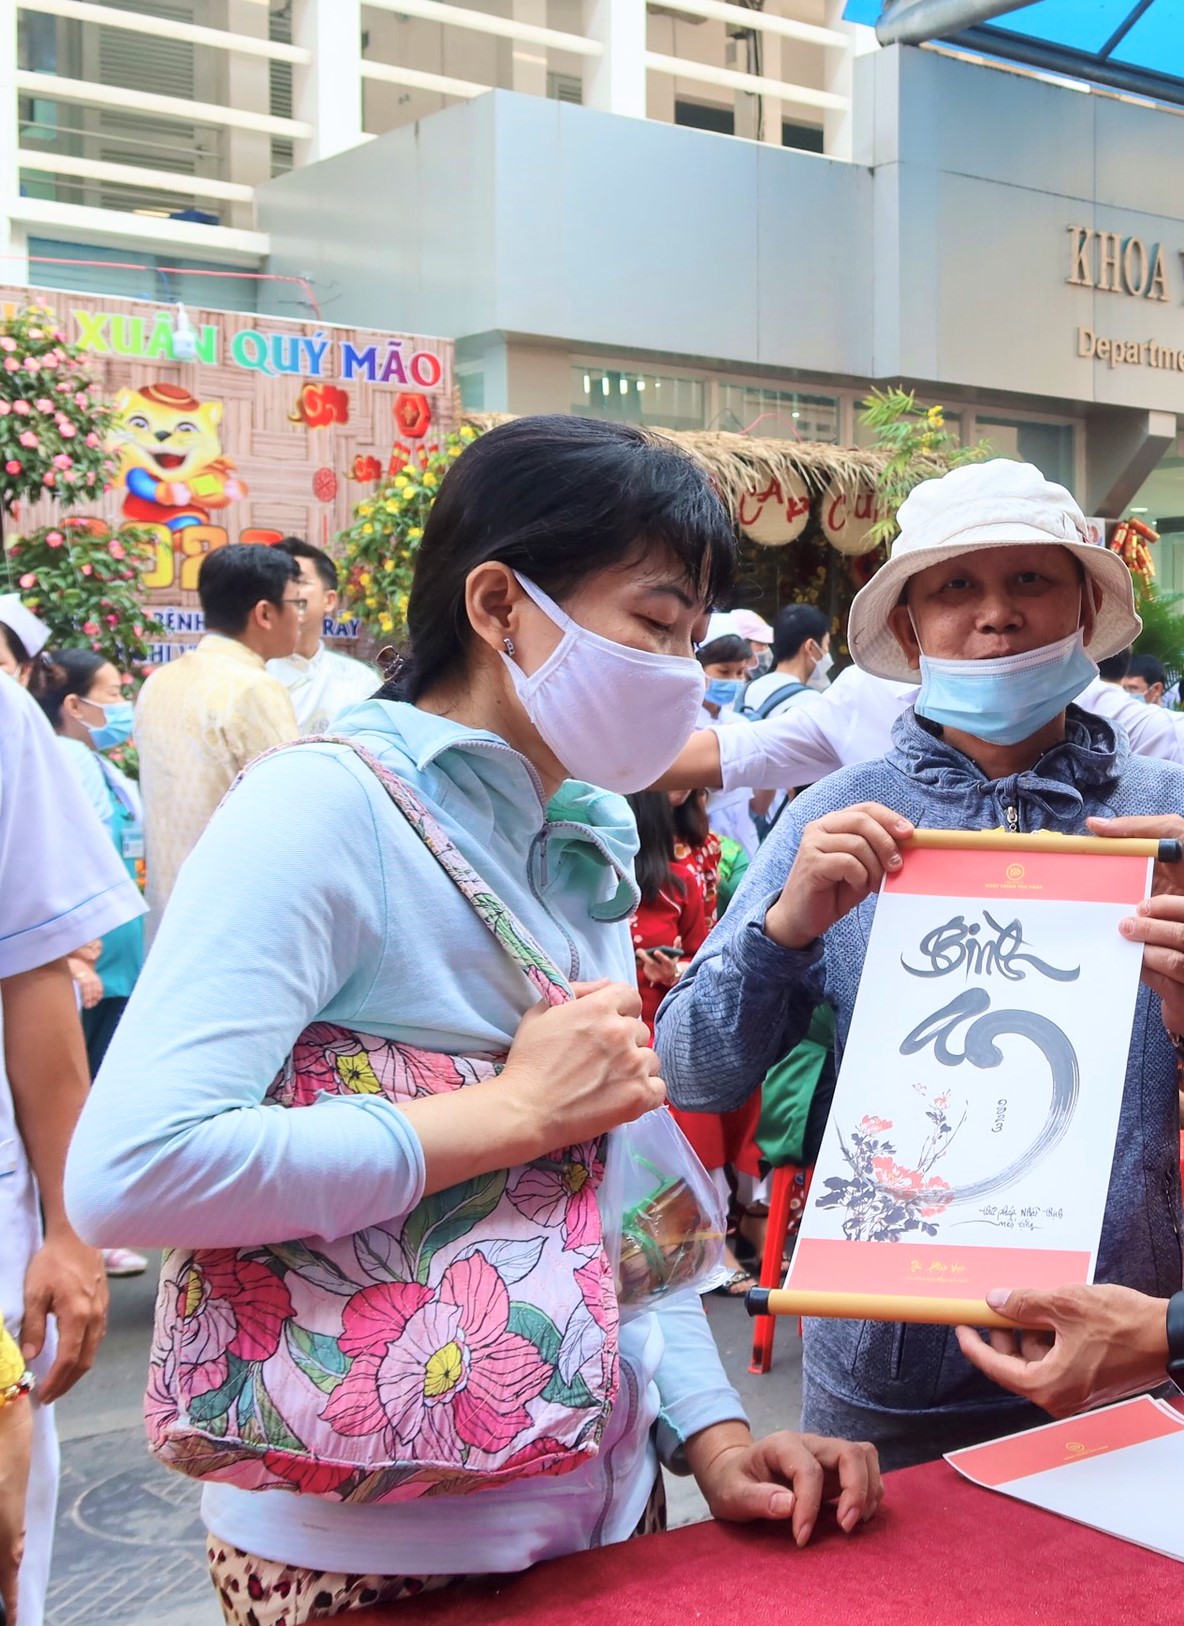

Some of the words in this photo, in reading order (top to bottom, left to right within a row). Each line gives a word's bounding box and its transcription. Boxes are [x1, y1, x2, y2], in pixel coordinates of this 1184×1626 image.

[1067, 225, 1171, 302] KHOA
[72, 309, 218, 366] XUÂN
[231, 329, 331, 378] QUÝ
[341, 339, 442, 388] MÃO
